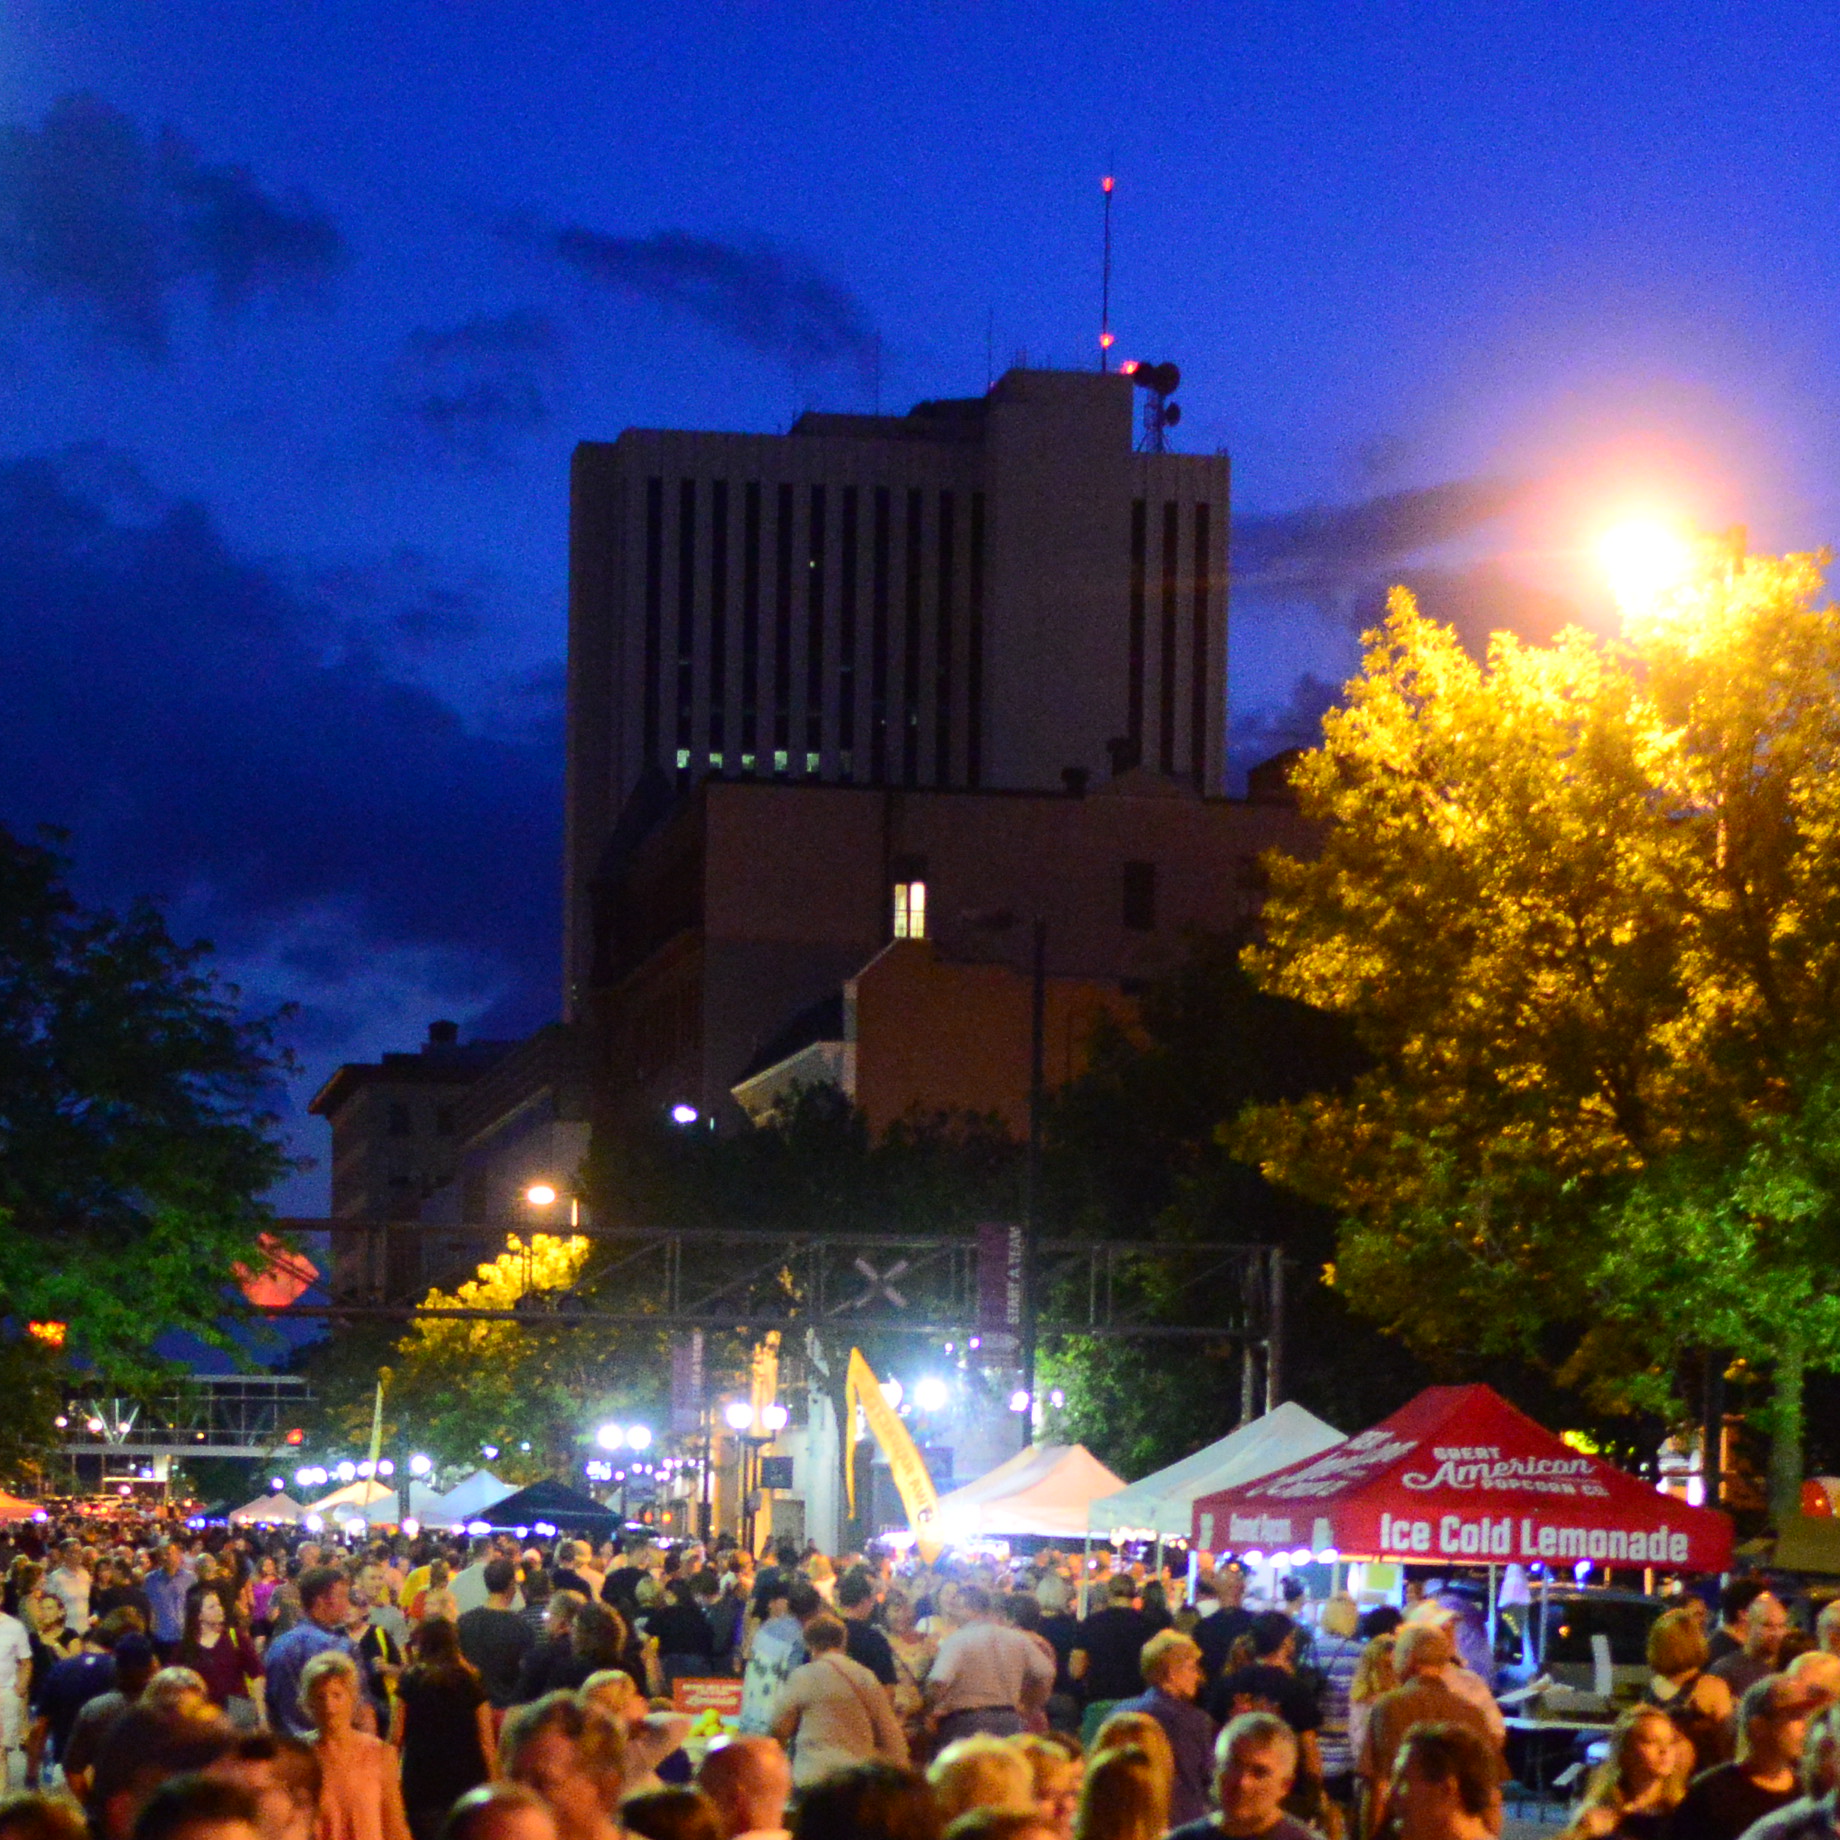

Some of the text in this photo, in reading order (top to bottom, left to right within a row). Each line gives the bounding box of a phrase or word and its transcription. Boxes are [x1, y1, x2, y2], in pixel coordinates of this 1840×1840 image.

[1401, 1455, 1597, 1490] American
[1481, 1478, 1576, 1495] POPCORN
[1380, 1513, 1689, 1563] Ice Cold Lemonade
